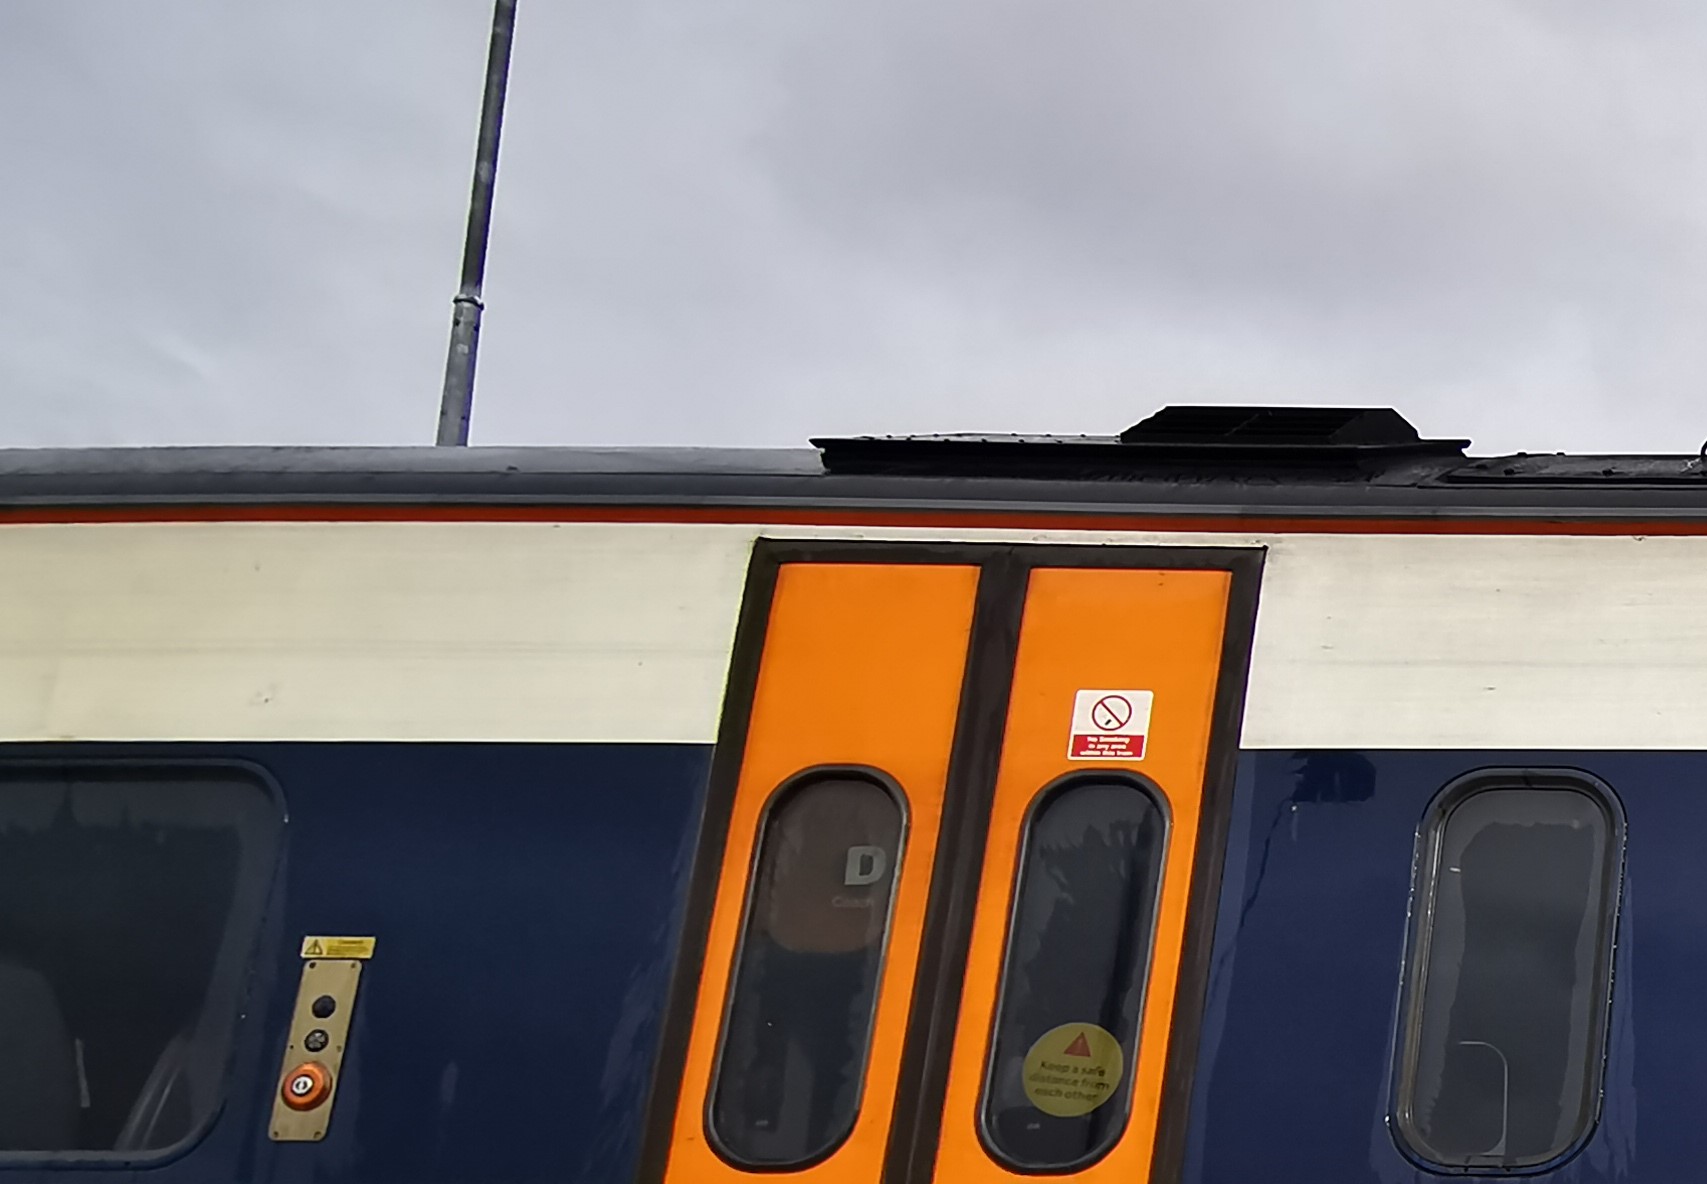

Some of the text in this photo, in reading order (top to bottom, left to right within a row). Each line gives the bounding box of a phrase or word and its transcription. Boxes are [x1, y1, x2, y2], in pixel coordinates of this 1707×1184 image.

[844, 846, 887, 885] D
[1041, 1061, 1106, 1077] Keep a safe
[1029, 1073, 1109, 1091] distance from
[1034, 1088, 1099, 1101] each other
